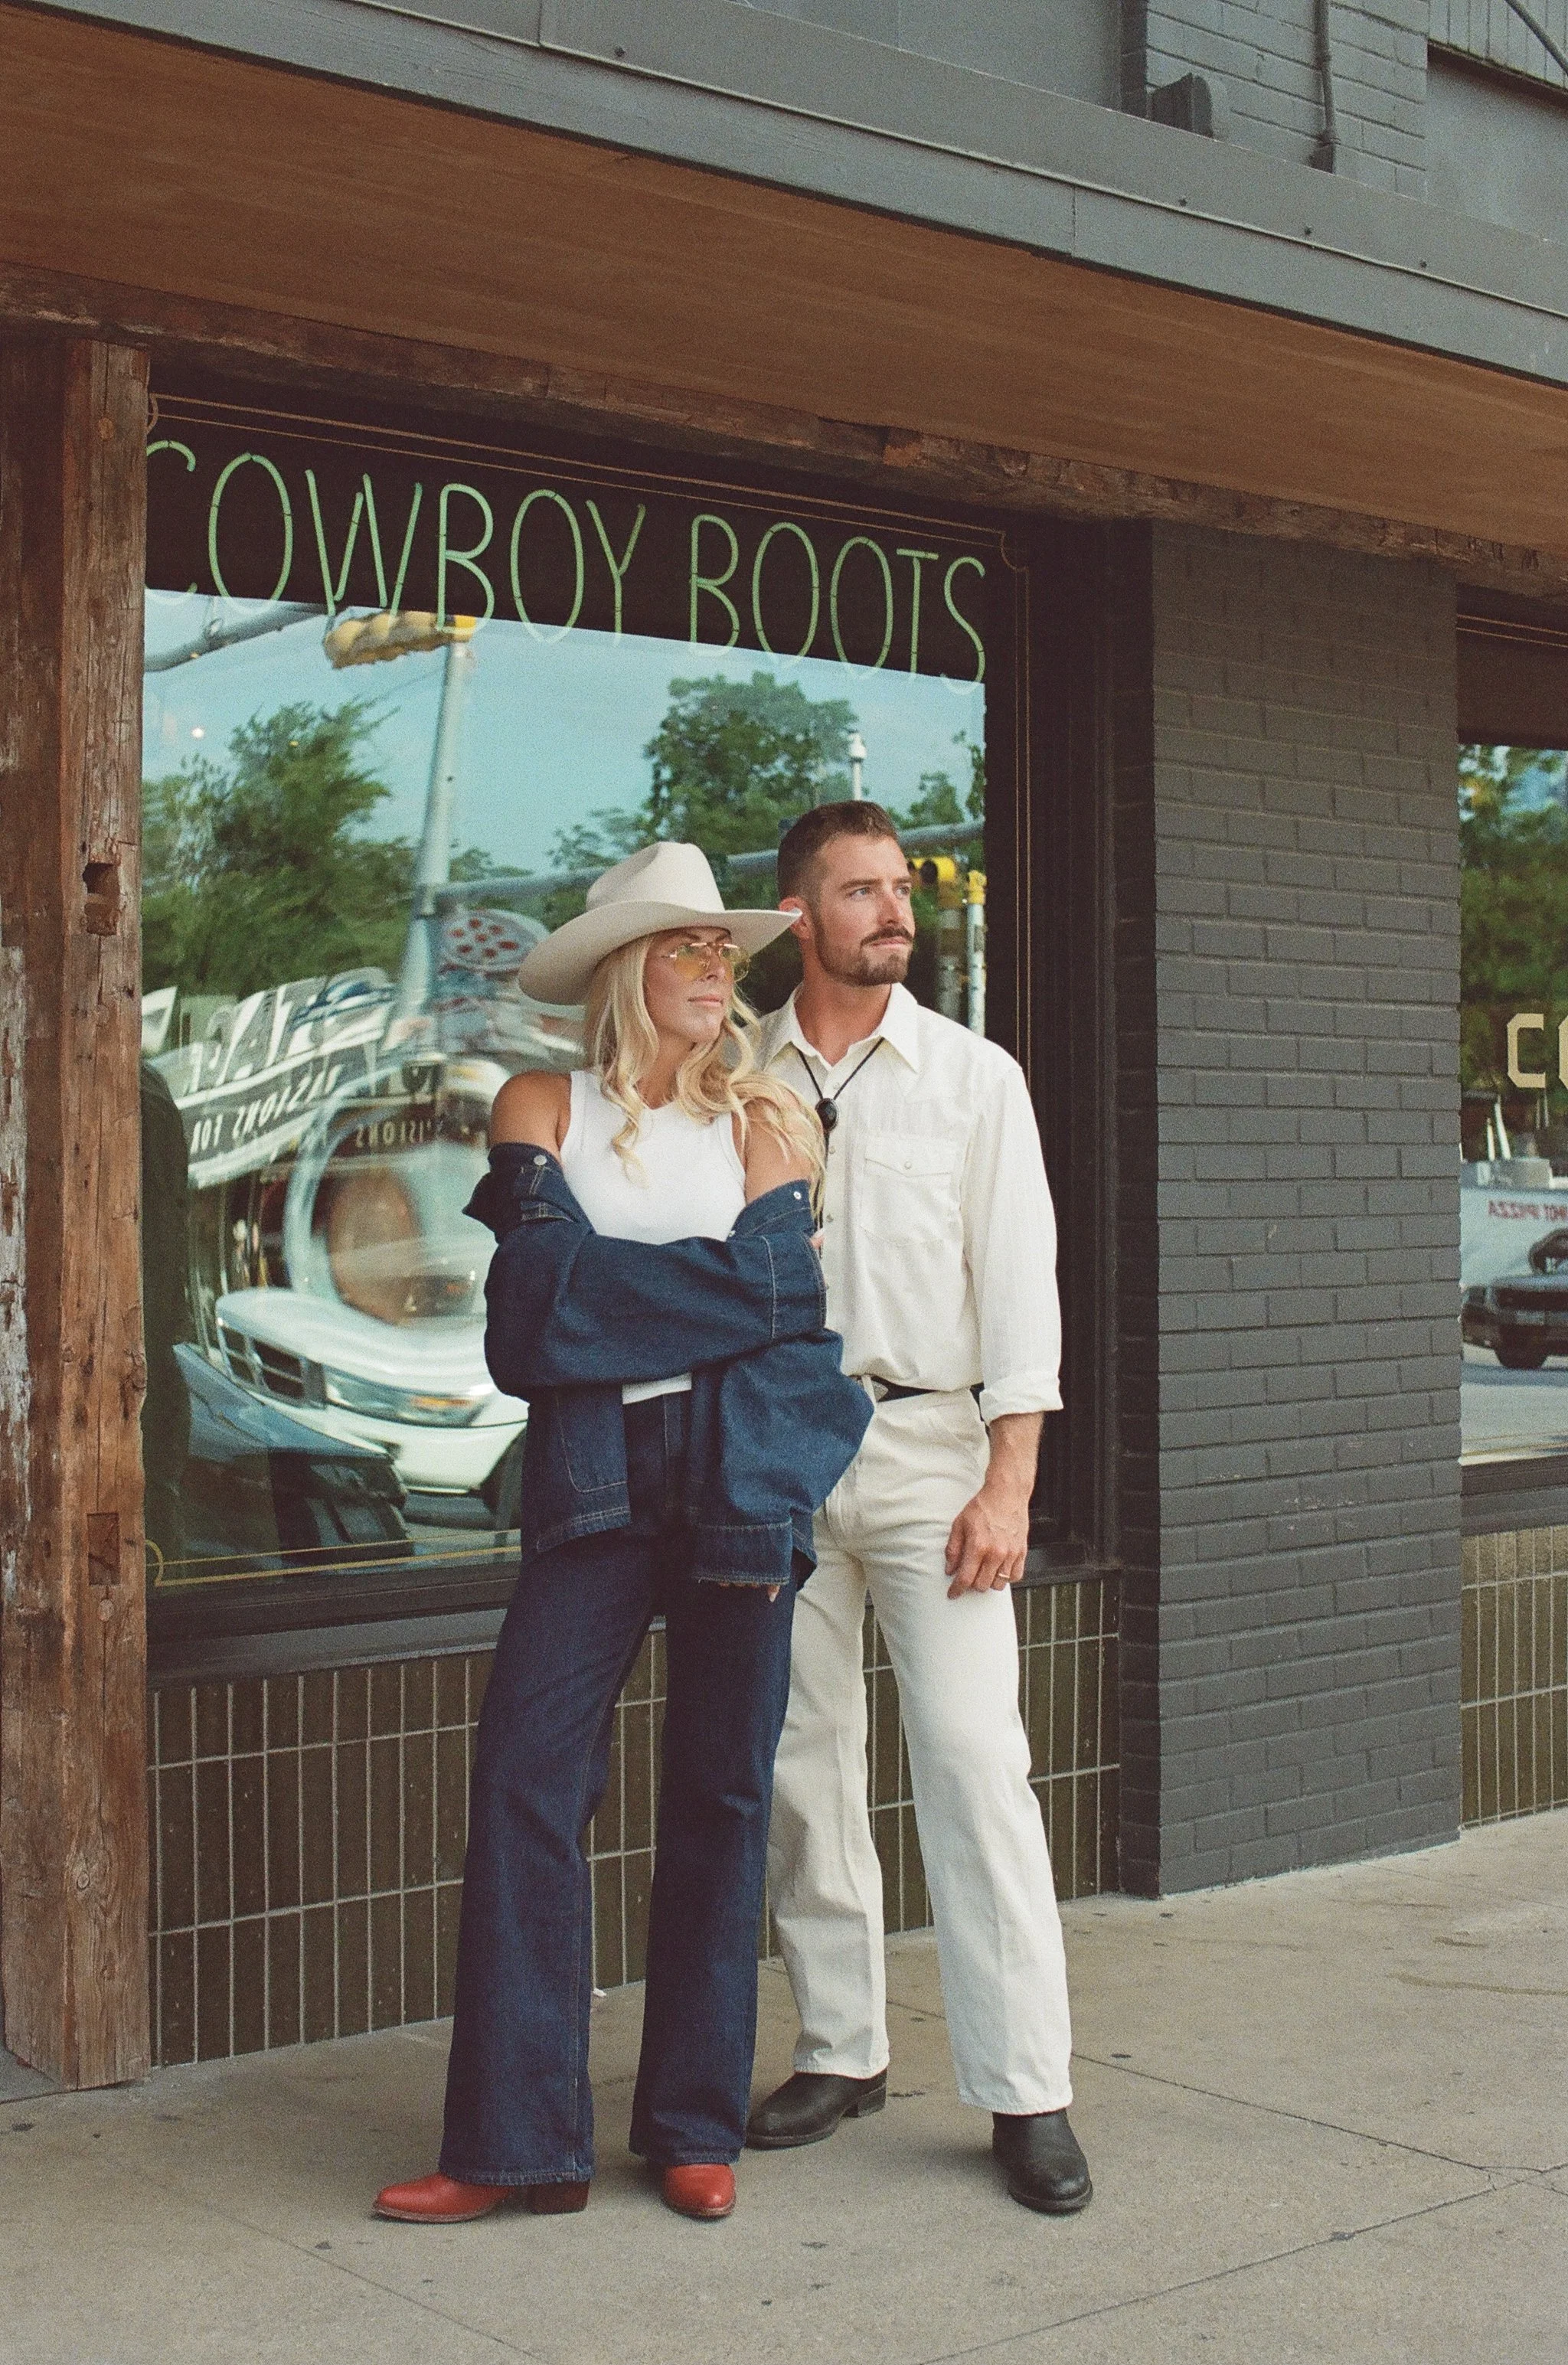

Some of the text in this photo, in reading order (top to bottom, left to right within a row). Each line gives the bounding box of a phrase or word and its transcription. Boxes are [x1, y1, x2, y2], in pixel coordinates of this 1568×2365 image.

[145, 440, 986, 695] COWBOY BOOTS
[1507, 1013, 1568, 1091] C
